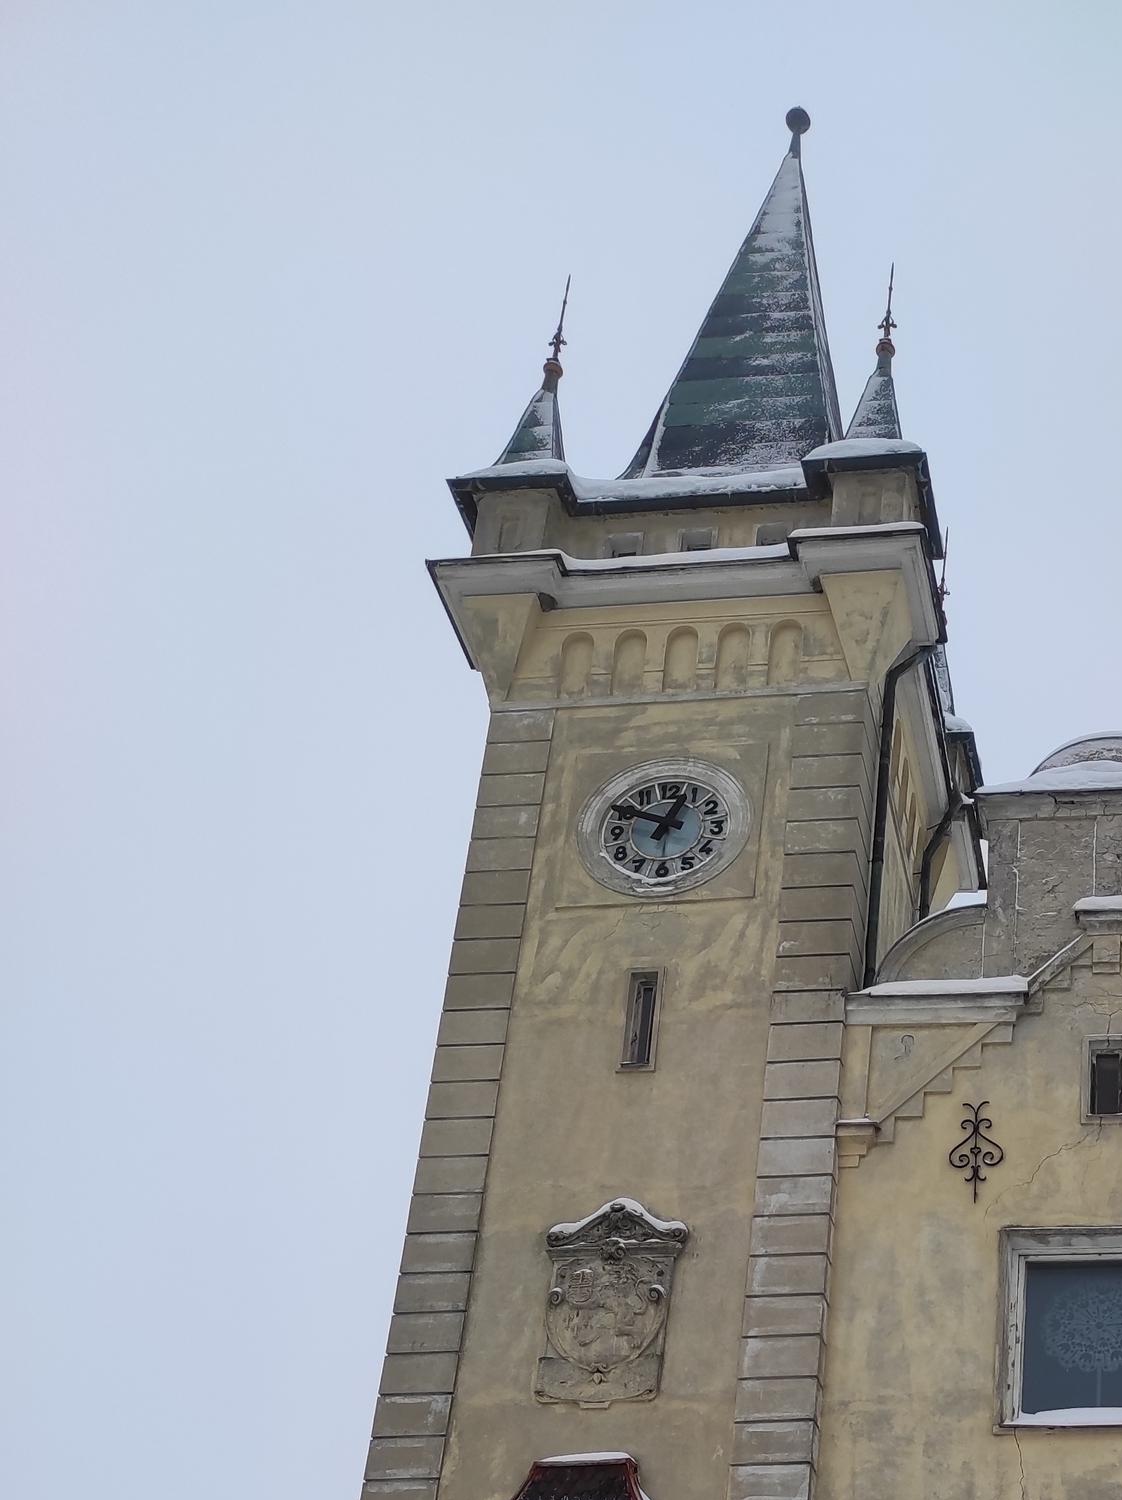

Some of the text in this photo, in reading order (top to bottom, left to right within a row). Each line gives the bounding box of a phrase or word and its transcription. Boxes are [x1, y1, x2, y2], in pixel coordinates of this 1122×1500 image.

[638, 790, 651, 806] 11
[661, 785, 681, 800] 12
[691, 787, 698, 802] 1
[704, 800, 718, 815] 2
[610, 826, 624, 841] 9
[709, 820, 723, 835] 3
[614, 846, 627, 861] 8
[699, 840, 713, 854] 4
[632, 859, 646, 873] 7
[655, 862, 669, 877] 6
[681, 856, 695, 871] 5
